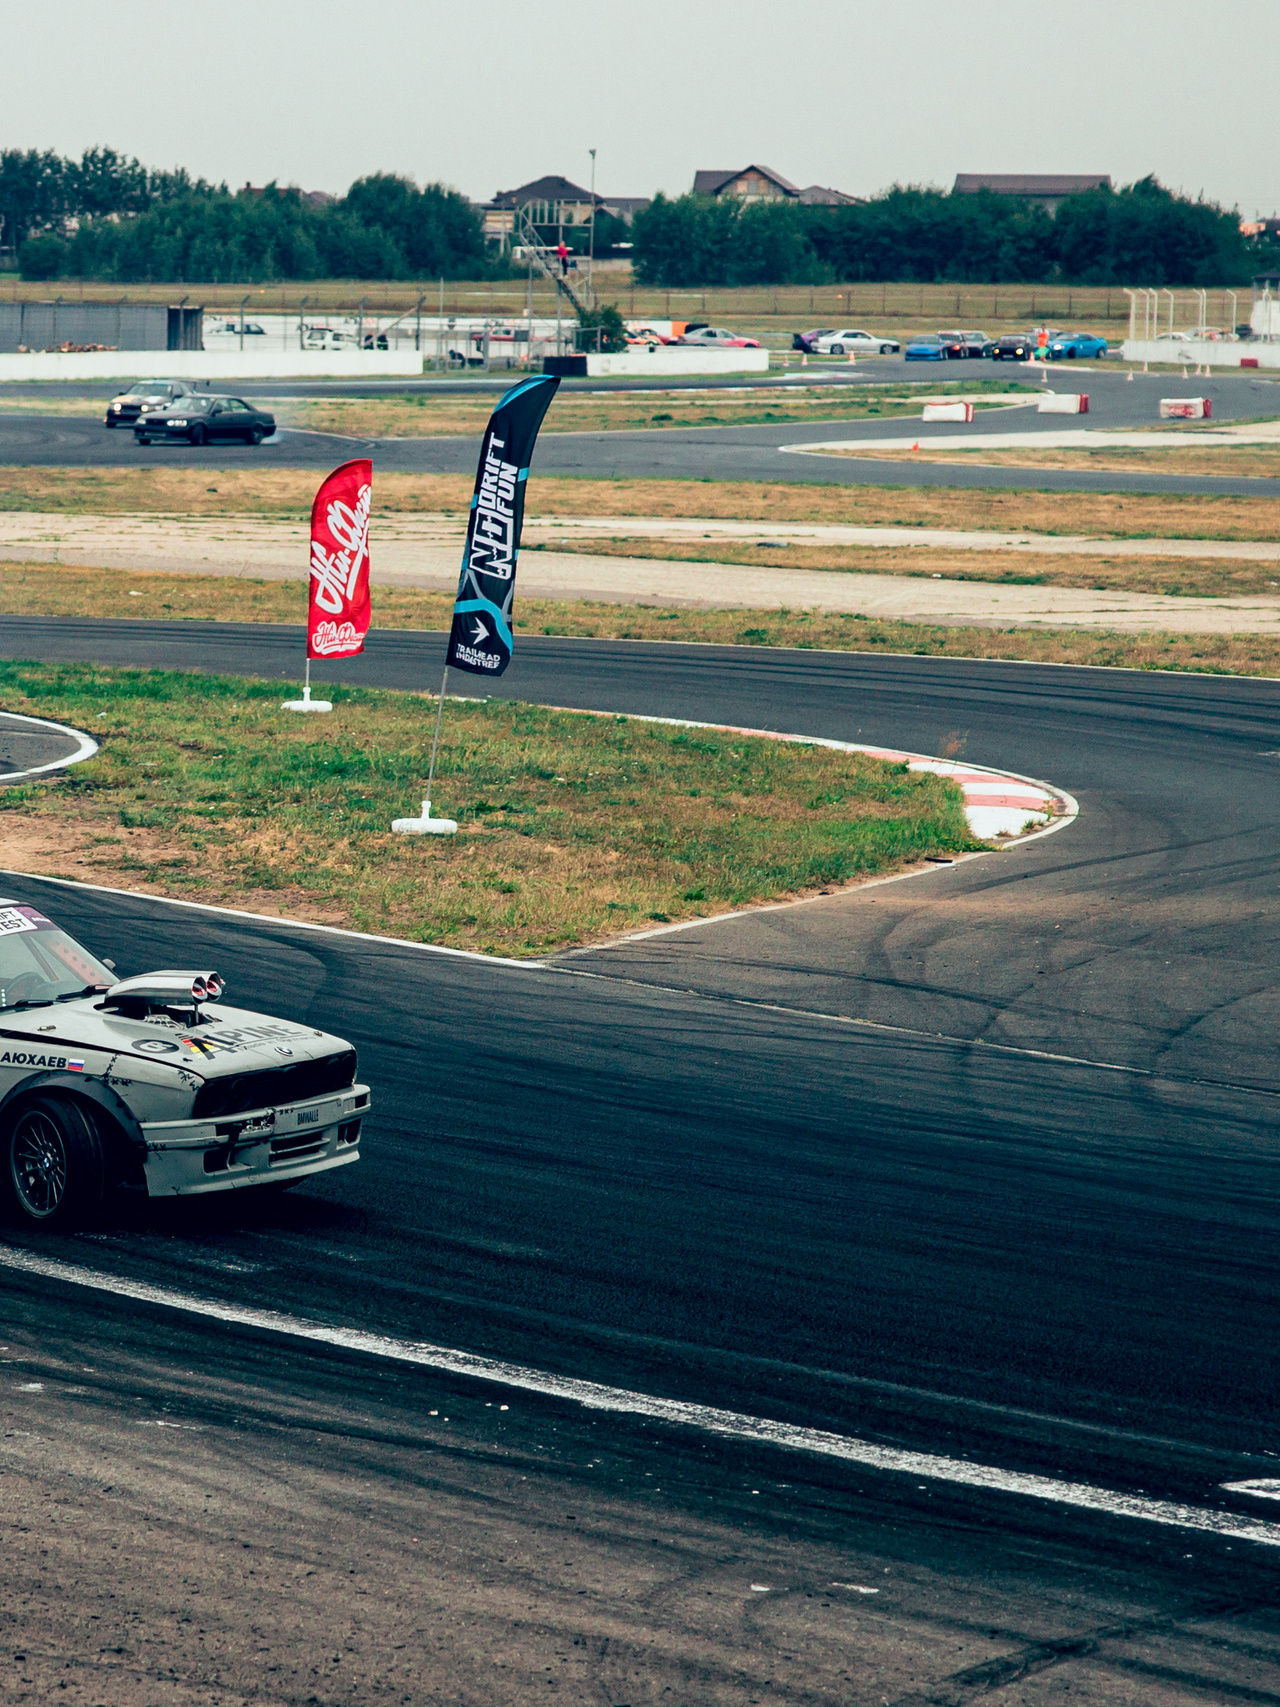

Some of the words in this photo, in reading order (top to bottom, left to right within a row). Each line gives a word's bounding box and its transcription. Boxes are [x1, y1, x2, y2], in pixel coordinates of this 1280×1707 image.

[478, 432, 506, 510] DRIFT
[496, 461, 519, 517] FUN
[457, 643, 501, 662] TRAILHEAD
[189, 1024, 303, 1061] ALPINE
